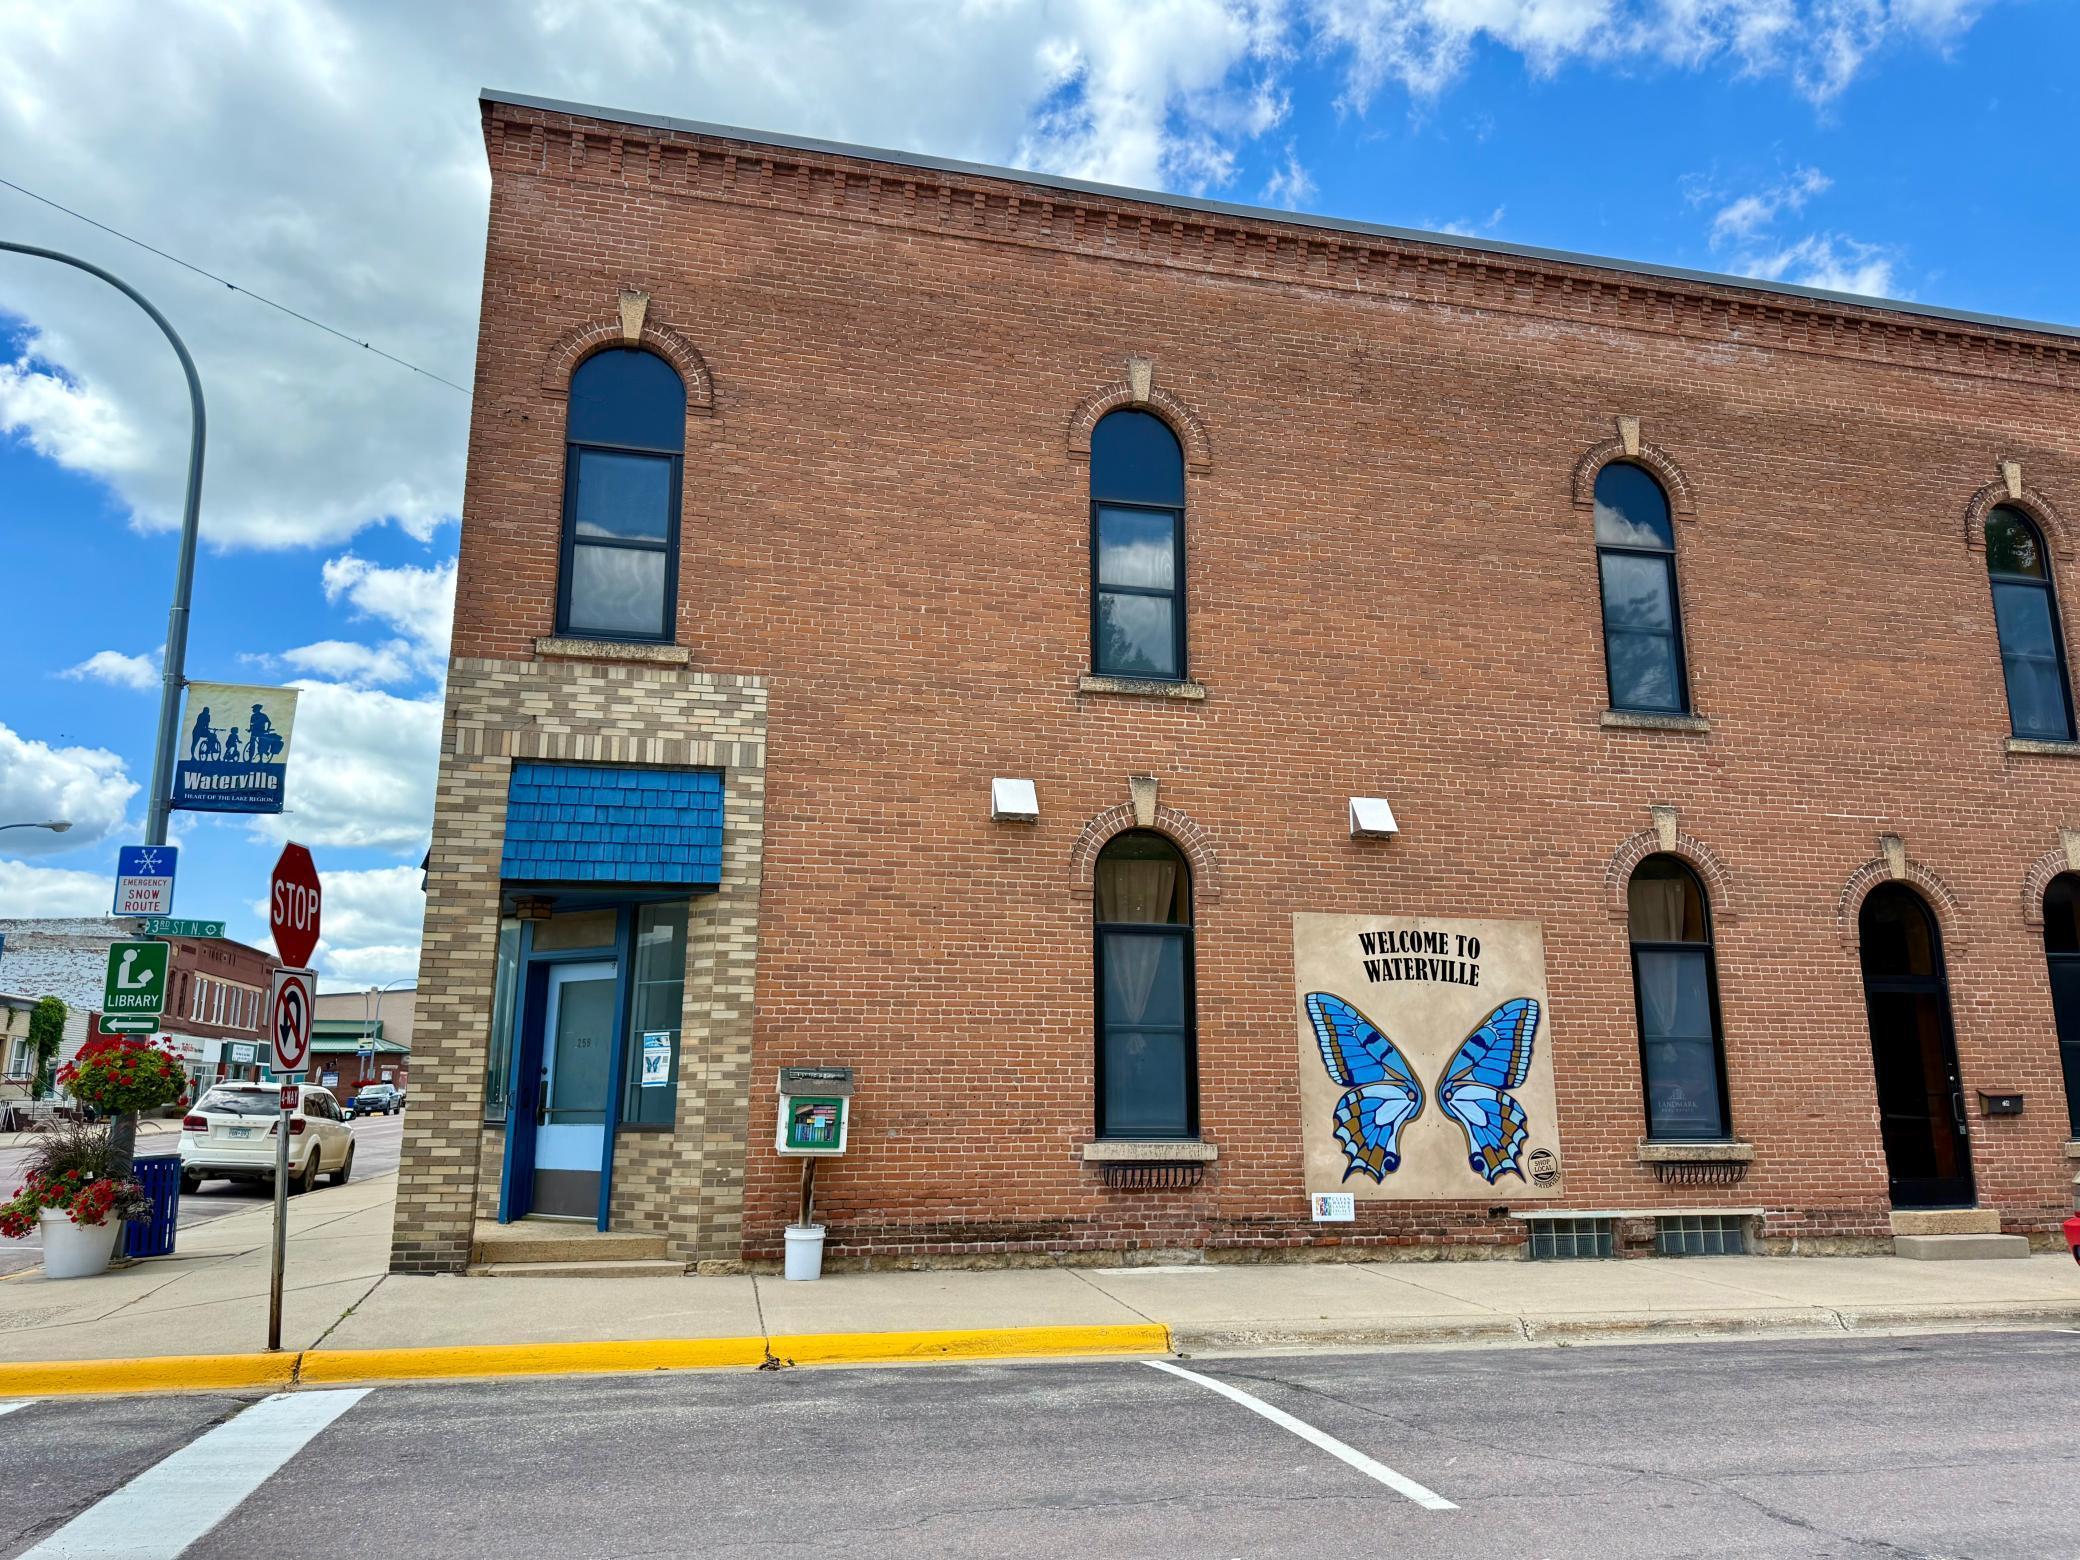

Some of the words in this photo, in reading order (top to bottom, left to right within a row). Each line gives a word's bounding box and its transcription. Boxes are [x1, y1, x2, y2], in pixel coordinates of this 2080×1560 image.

[184, 771, 278, 790] Waterville
[123, 878, 168, 886] EMERGENCY
[128, 889, 160, 900] SNOW
[124, 901, 161, 912] ROUTE
[273, 879, 319, 931] STOP
[172, 921, 186, 934] ST
[1358, 930, 1449, 955] WELCOME
[1456, 934, 1481, 959] TO
[1363, 957, 1480, 987] WATERVILLE
[107, 994, 159, 1007] LIBRARY
[281, 1090, 299, 1105] 4-WAY
[1534, 1159, 1551, 1167] SHOP
